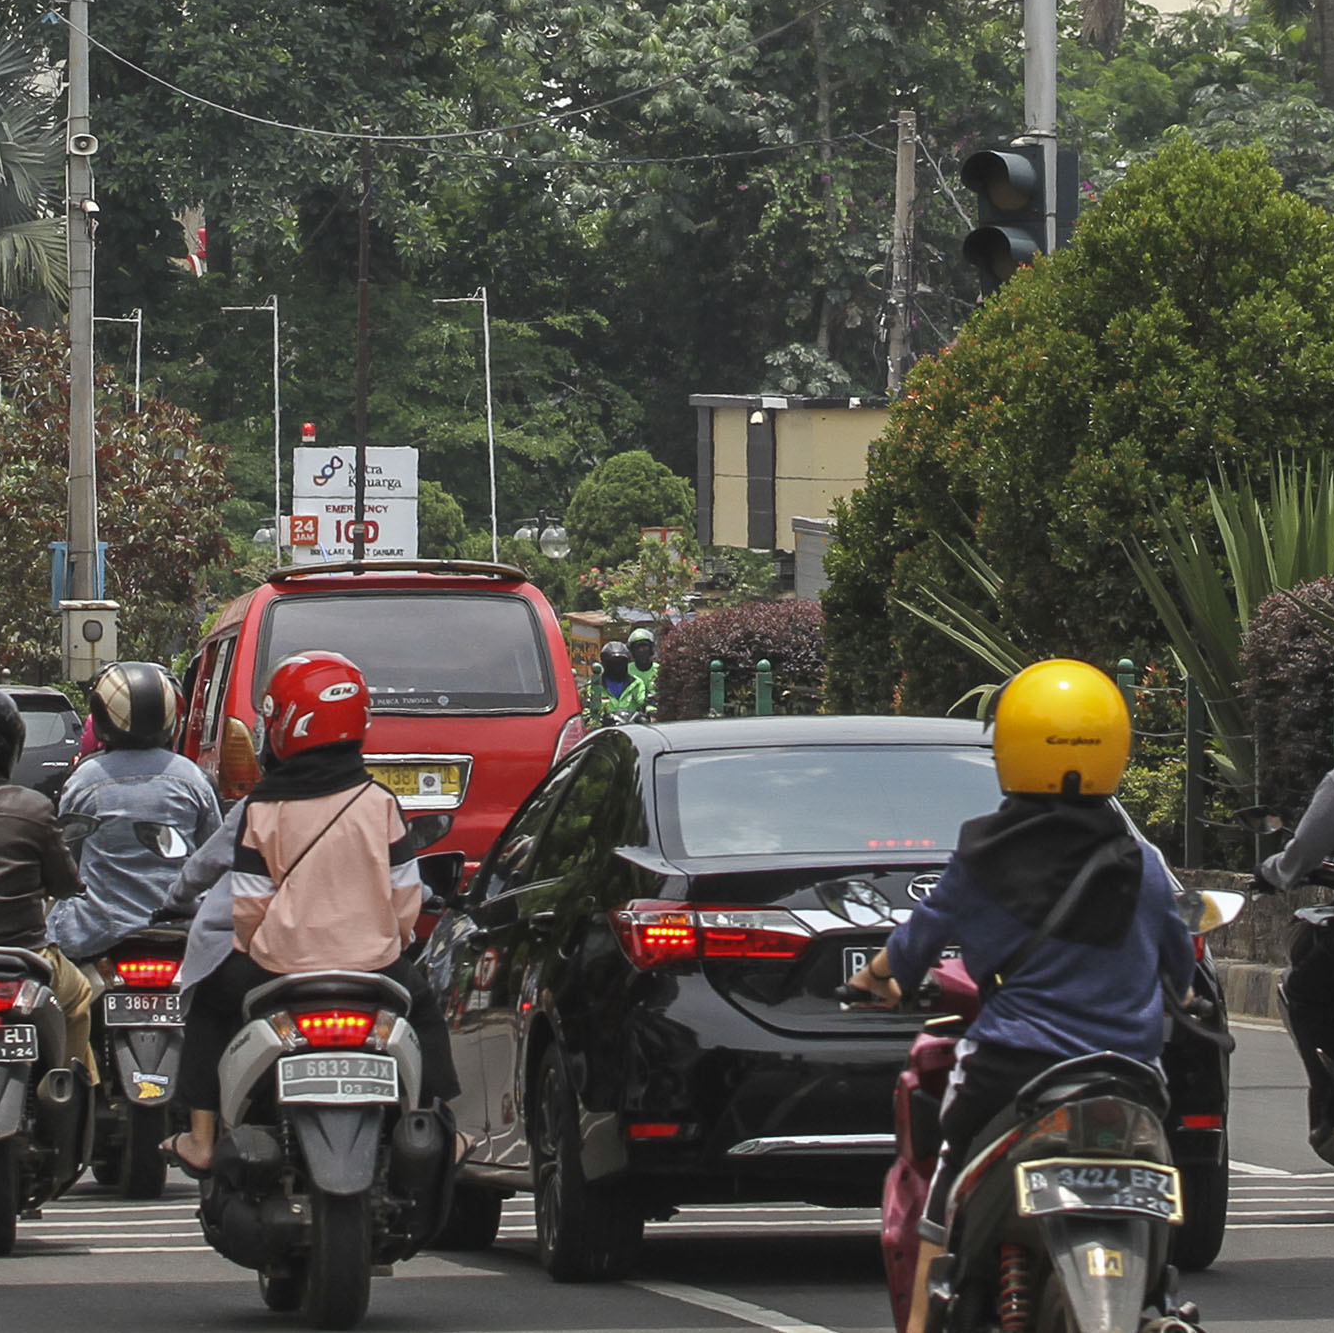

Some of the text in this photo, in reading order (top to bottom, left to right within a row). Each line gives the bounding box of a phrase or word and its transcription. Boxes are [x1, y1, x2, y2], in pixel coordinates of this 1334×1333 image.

[294, 520, 315, 533] 24
[293, 533, 315, 542] JAM
[108, 997, 117, 1010] B
[125, 997, 159, 1010] 3867
[285, 1060, 391, 1079] B 6833 ZJX
[1029, 1172, 1047, 1191] B
[1059, 1168, 1120, 1187] 3424
